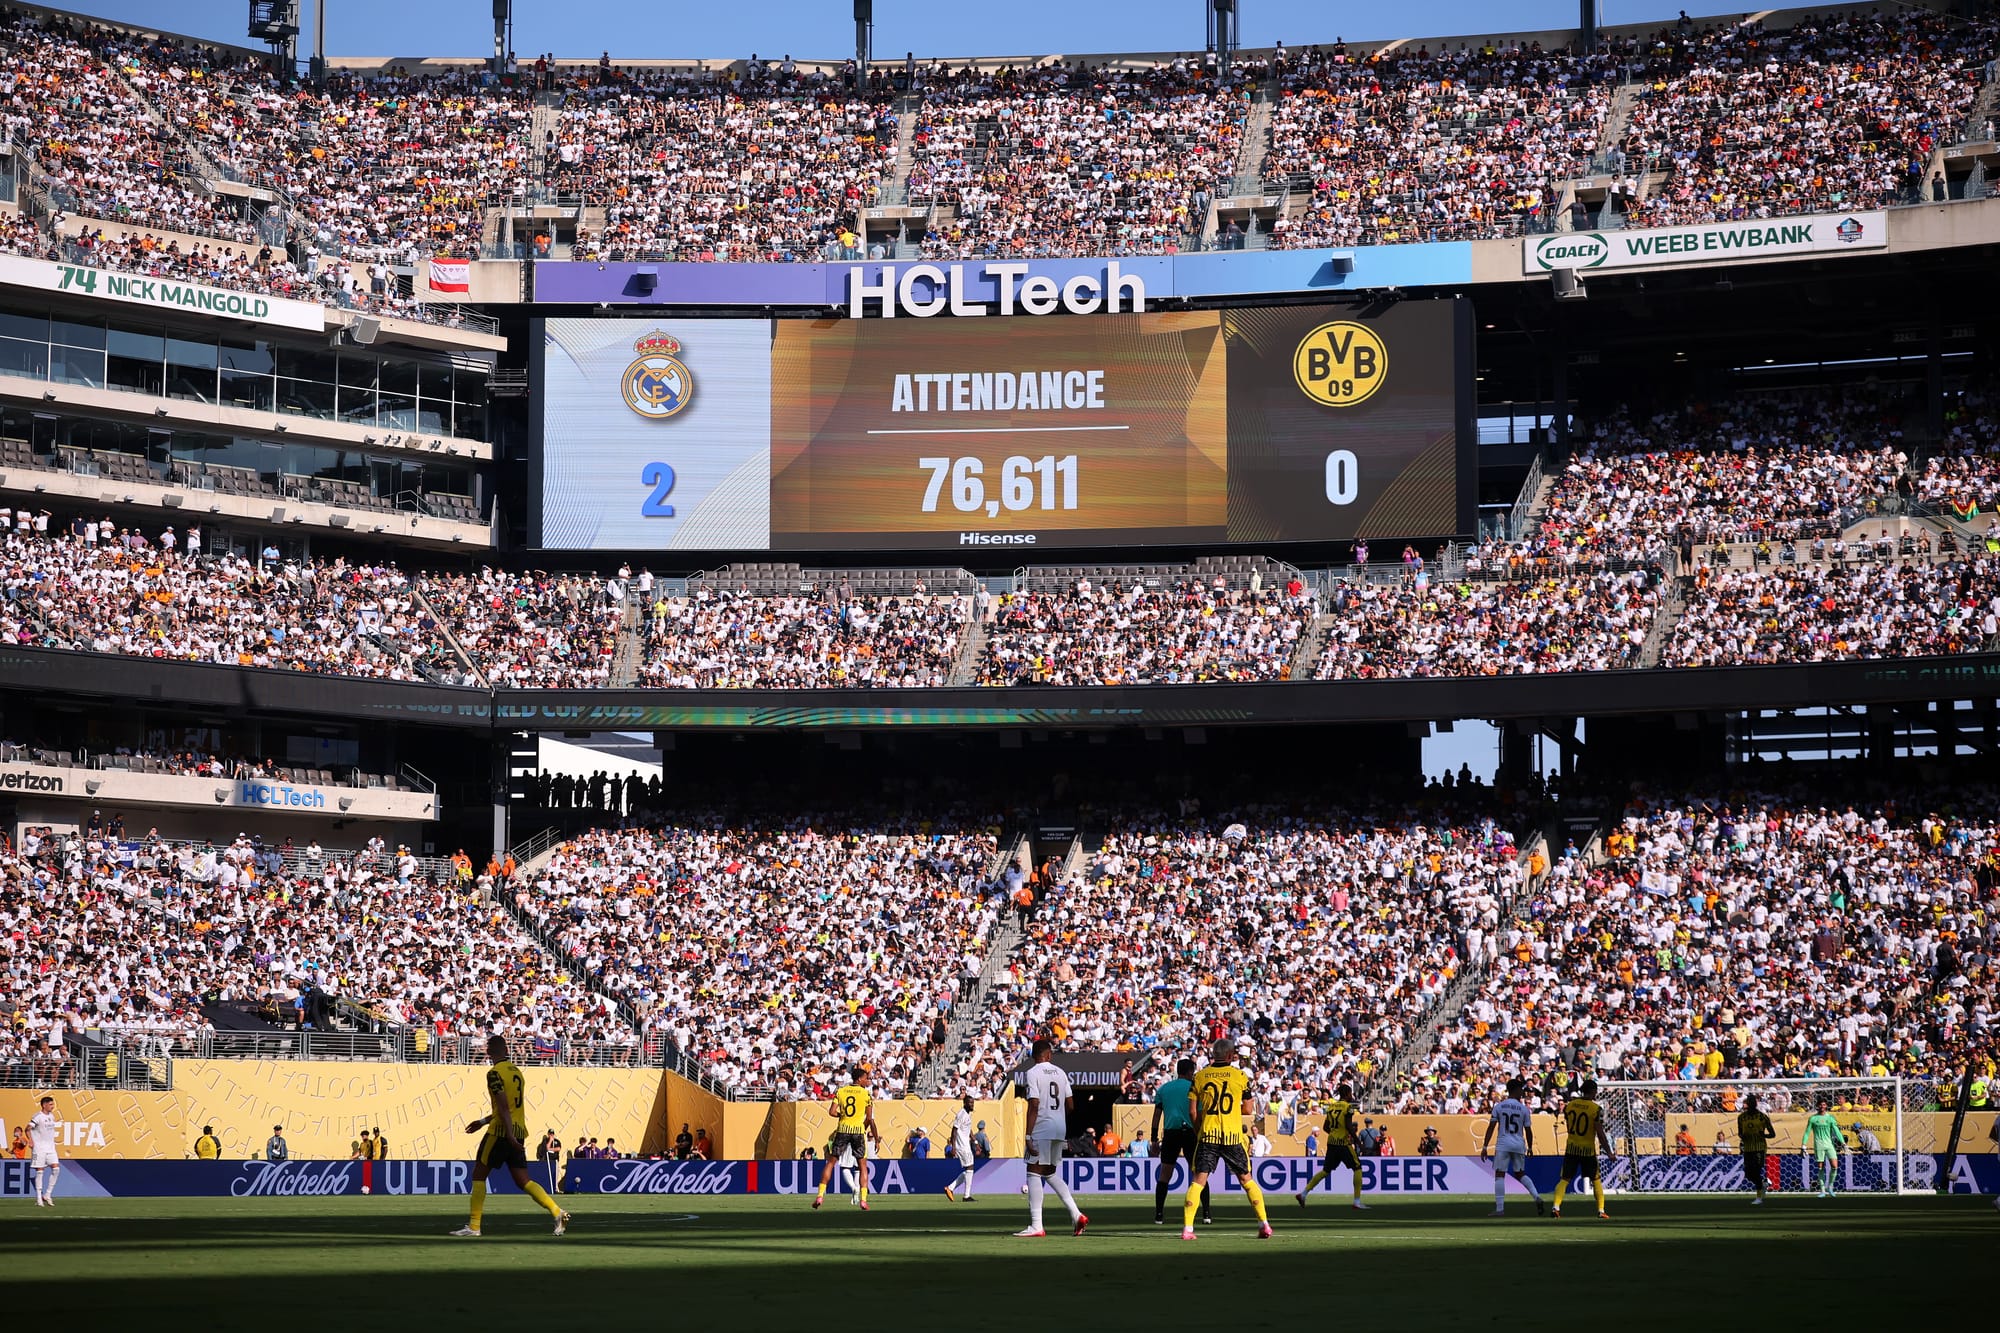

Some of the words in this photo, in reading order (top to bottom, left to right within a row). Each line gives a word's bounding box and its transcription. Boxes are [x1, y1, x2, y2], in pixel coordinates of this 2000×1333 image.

[1544, 243, 1601, 260] COACH
[1626, 234, 1699, 256] WEEB
[1704, 225, 1813, 250] EWBANK
[57, 265, 97, 294] 74
[107, 276, 156, 300] NICK
[160, 280, 268, 318] MANGOLD
[849, 262, 1146, 318] HCLTech
[1307, 331, 1377, 381] BVB
[891, 370, 1105, 412] ATTENDANCE
[1328, 380, 1354, 397] 09
[641, 461, 676, 517] 2
[918, 455, 1079, 518] 76,611
[1325, 449, 1359, 506] 0
[959, 532, 1037, 545] Hisense
[242, 783, 325, 809] HCLTech
[513, 1075, 524, 1108] 3
[1069, 1071, 1120, 1086] STADIUM
[845, 1095, 856, 1118] 8
[1049, 1081, 1060, 1111] 9
[1203, 1081, 1234, 1116] 26
[1327, 1108, 1343, 1129] 17
[1502, 1113, 1519, 1134] 15
[1567, 1110, 1589, 1136] 20
[230, 1160, 354, 1196] Michelob
[599, 1159, 738, 1194] Michelob
[1224, 1159, 1332, 1191] LGHT
[1360, 1159, 1449, 1191] BEER
